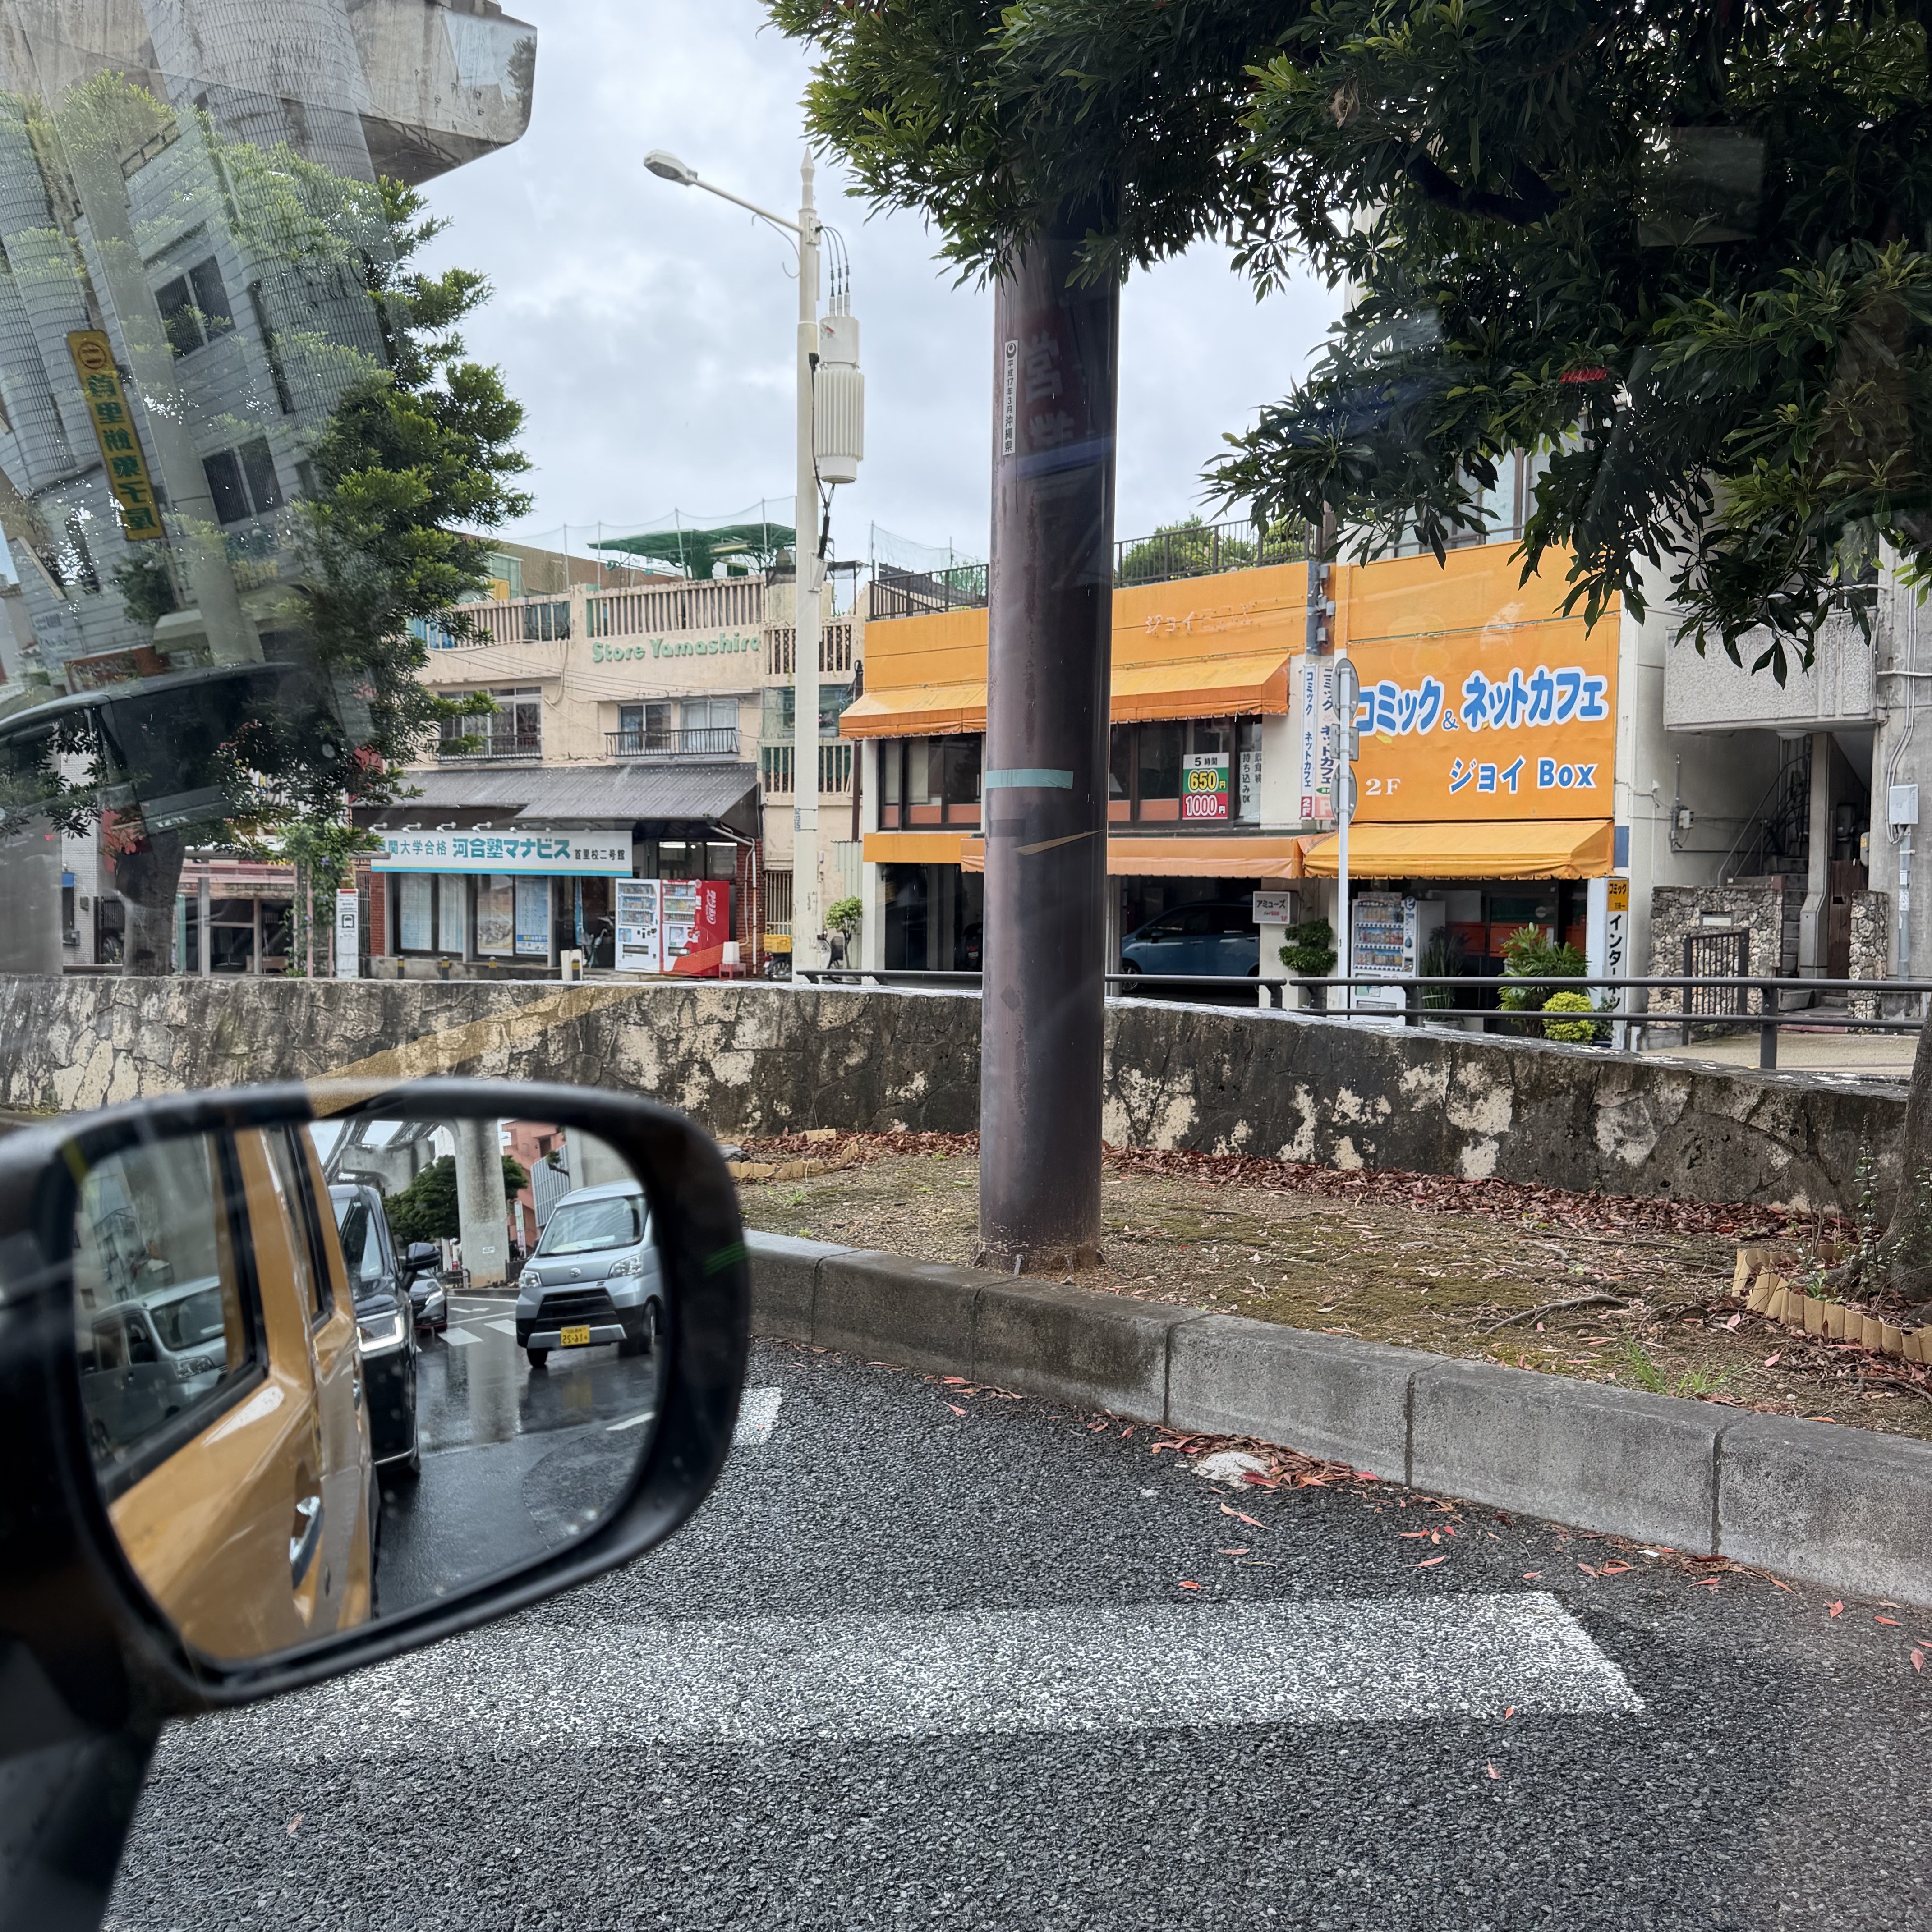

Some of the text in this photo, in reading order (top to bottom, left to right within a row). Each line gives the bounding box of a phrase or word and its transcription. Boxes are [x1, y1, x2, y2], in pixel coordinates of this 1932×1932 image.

[592, 642, 645, 663] Store
[1355, 669, 1605, 735] コミック & ネットカフェ
[1304, 731, 1312, 788] ネットカフェ
[1189, 769, 1226, 792] 650円
[1449, 756, 1597, 794] ジョイ Box
[1366, 778, 1401, 796] 2F
[1186, 795, 1225, 817] 1000円
[1302, 798, 1311, 817] 2F
[452, 837, 571, 859] 河合塾マナビス
[575, 849, 625, 860] 首里校二号館
[1256, 899, 1286, 908] アミューズ
